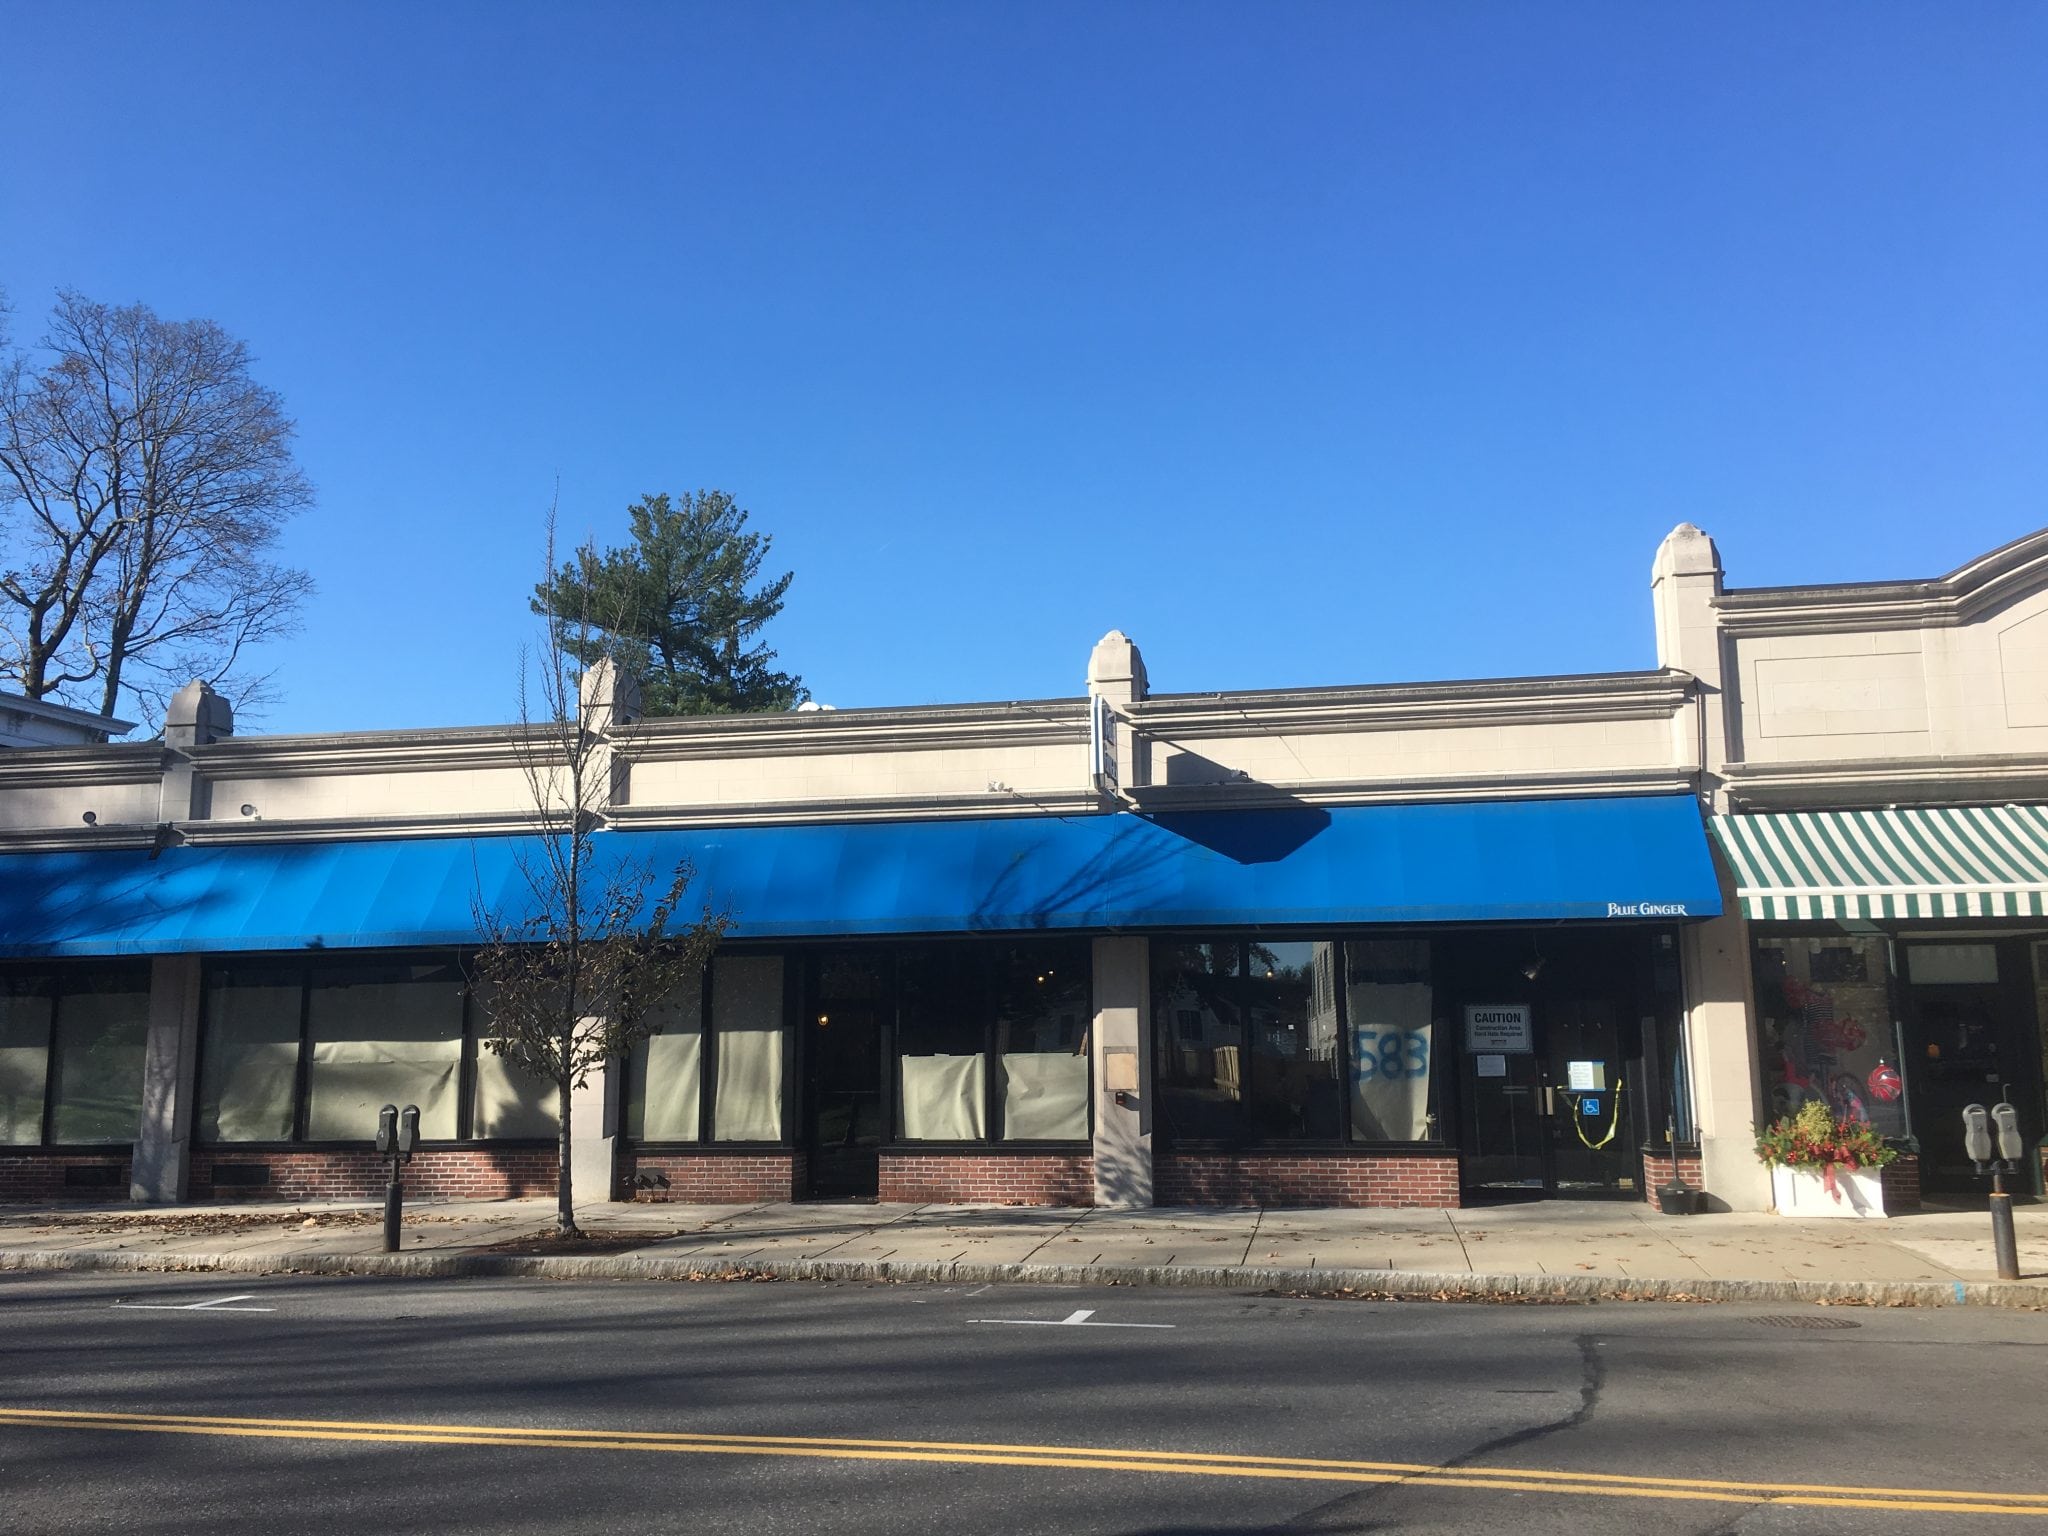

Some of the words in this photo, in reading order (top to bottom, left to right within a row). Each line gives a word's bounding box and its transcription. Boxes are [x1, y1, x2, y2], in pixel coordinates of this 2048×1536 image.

[1607, 902, 1639, 918] BLUE
[1640, 902, 1689, 917] GINGER
[1474, 1012, 1521, 1023] CAUTION
[1353, 1031, 1428, 1079] 583
